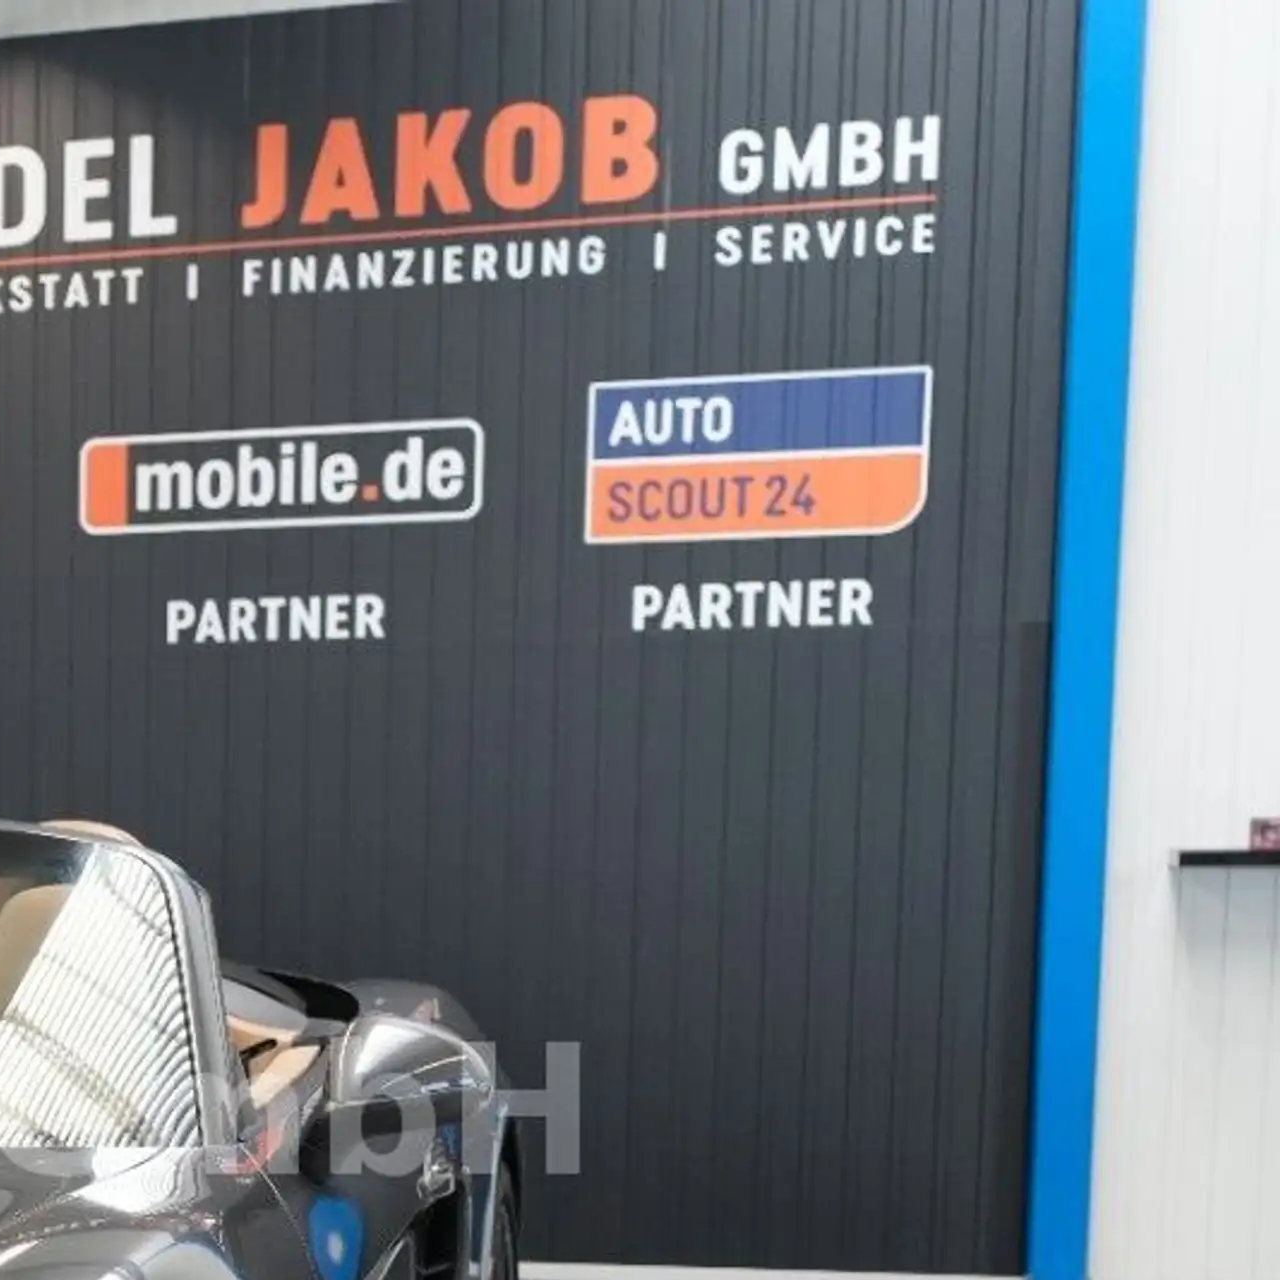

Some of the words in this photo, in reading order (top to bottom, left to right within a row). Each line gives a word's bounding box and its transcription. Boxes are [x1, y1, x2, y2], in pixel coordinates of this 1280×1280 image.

[241, 94, 659, 229] JAKOB
[719, 115, 941, 195] GMBH
[243, 234, 606, 297] FINANZIERUNG
[715, 211, 936, 267] SERVICE
[608, 396, 733, 446] AUTO
[134, 437, 466, 513] mobile.de
[607, 476, 750, 523] SCOUT
[764, 474, 817, 518] 24
[166, 593, 385, 644] PARTNER
[632, 578, 873, 631] PARTNER
